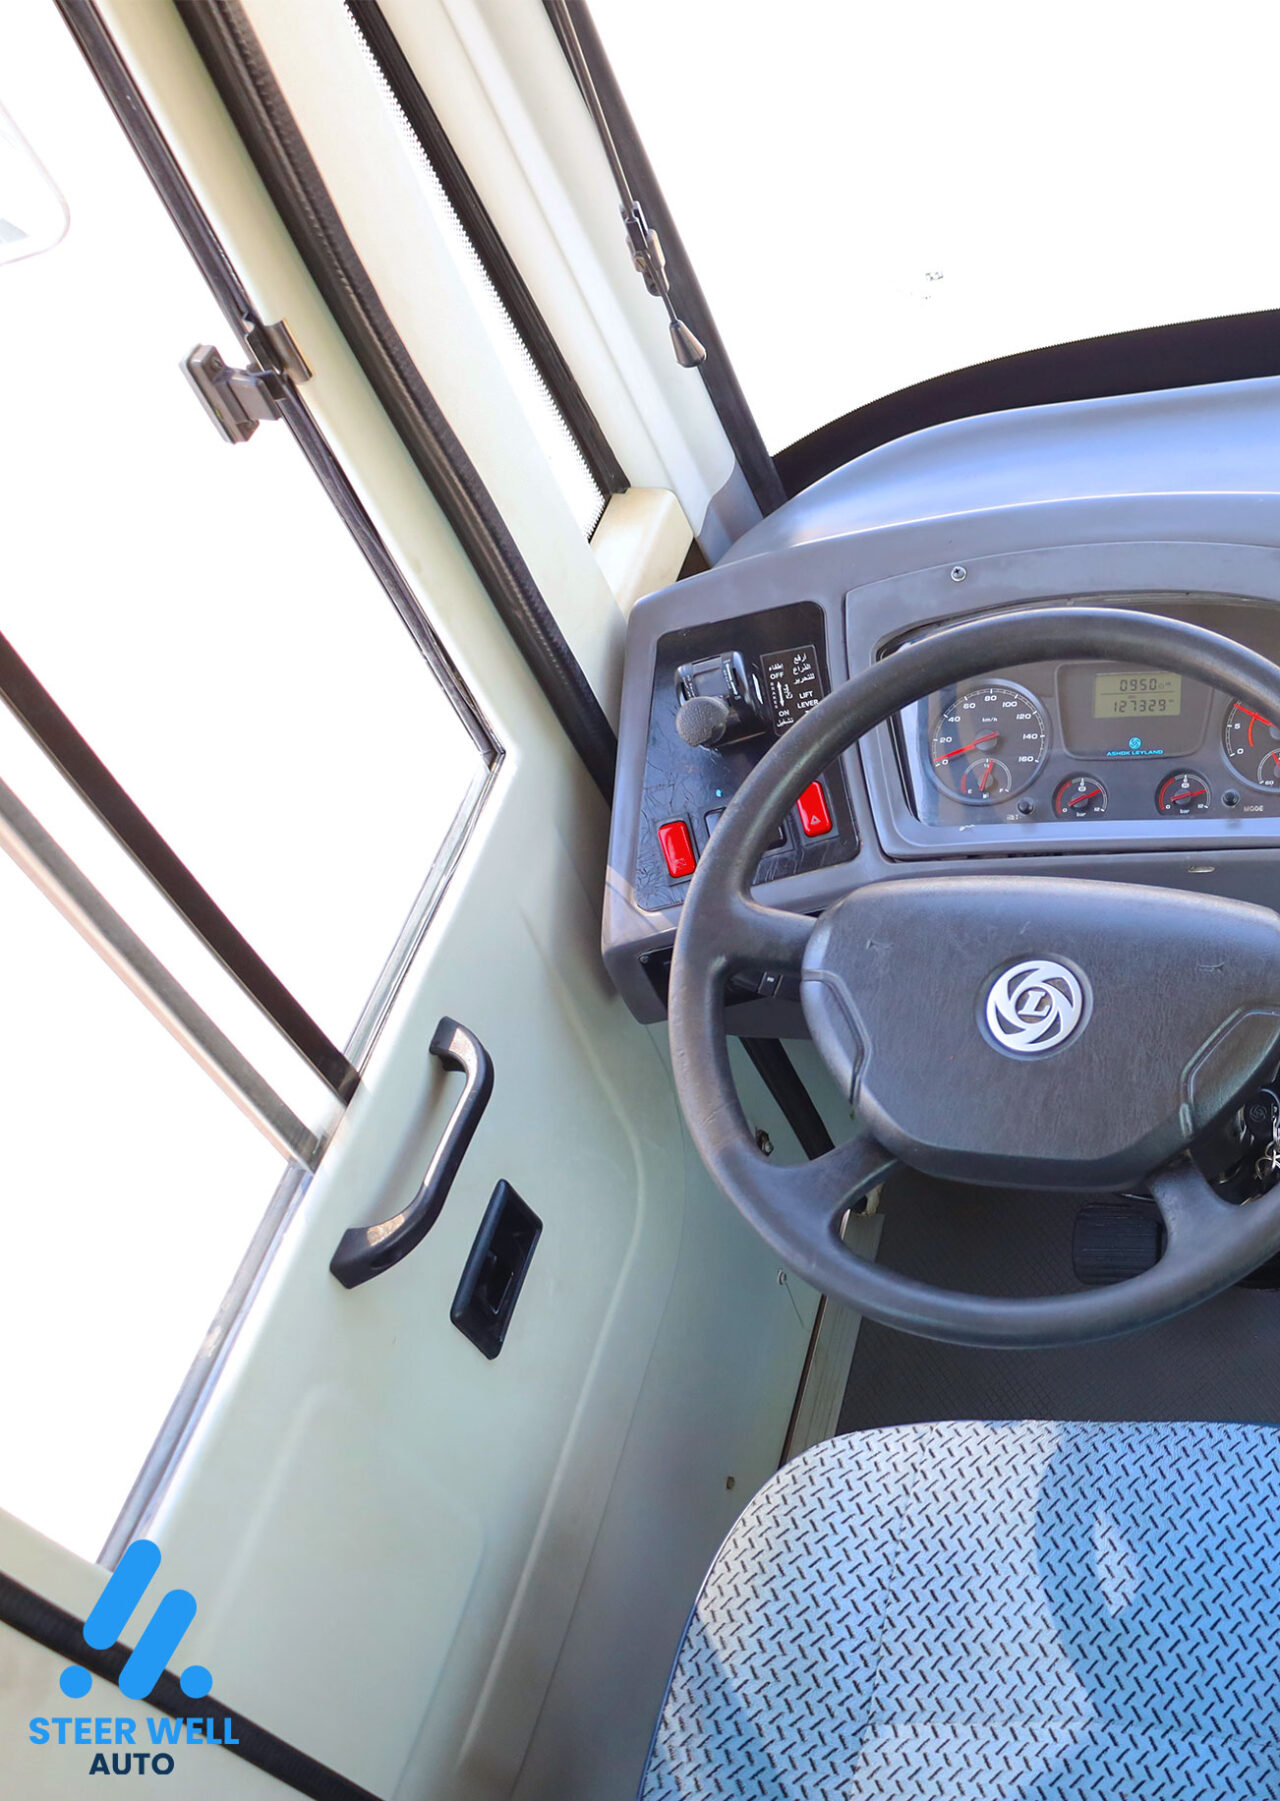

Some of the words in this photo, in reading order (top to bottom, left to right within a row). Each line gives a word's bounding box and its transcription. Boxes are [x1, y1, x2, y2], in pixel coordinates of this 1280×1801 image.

[769, 671, 785, 680] OFF
[799, 690, 814, 699] LIFT
[796, 699, 819, 709] LEVER
[1002, 700, 1018, 708] 100
[1113, 698, 1167, 713] 127329
[778, 709, 791, 717] ON
[1234, 722, 1241, 730] 5
[1023, 732, 1038, 740] 140
[1131, 748, 1165, 756] LEYLAND
[1236, 747, 1245, 755] 0
[941, 758, 949, 766] 0
